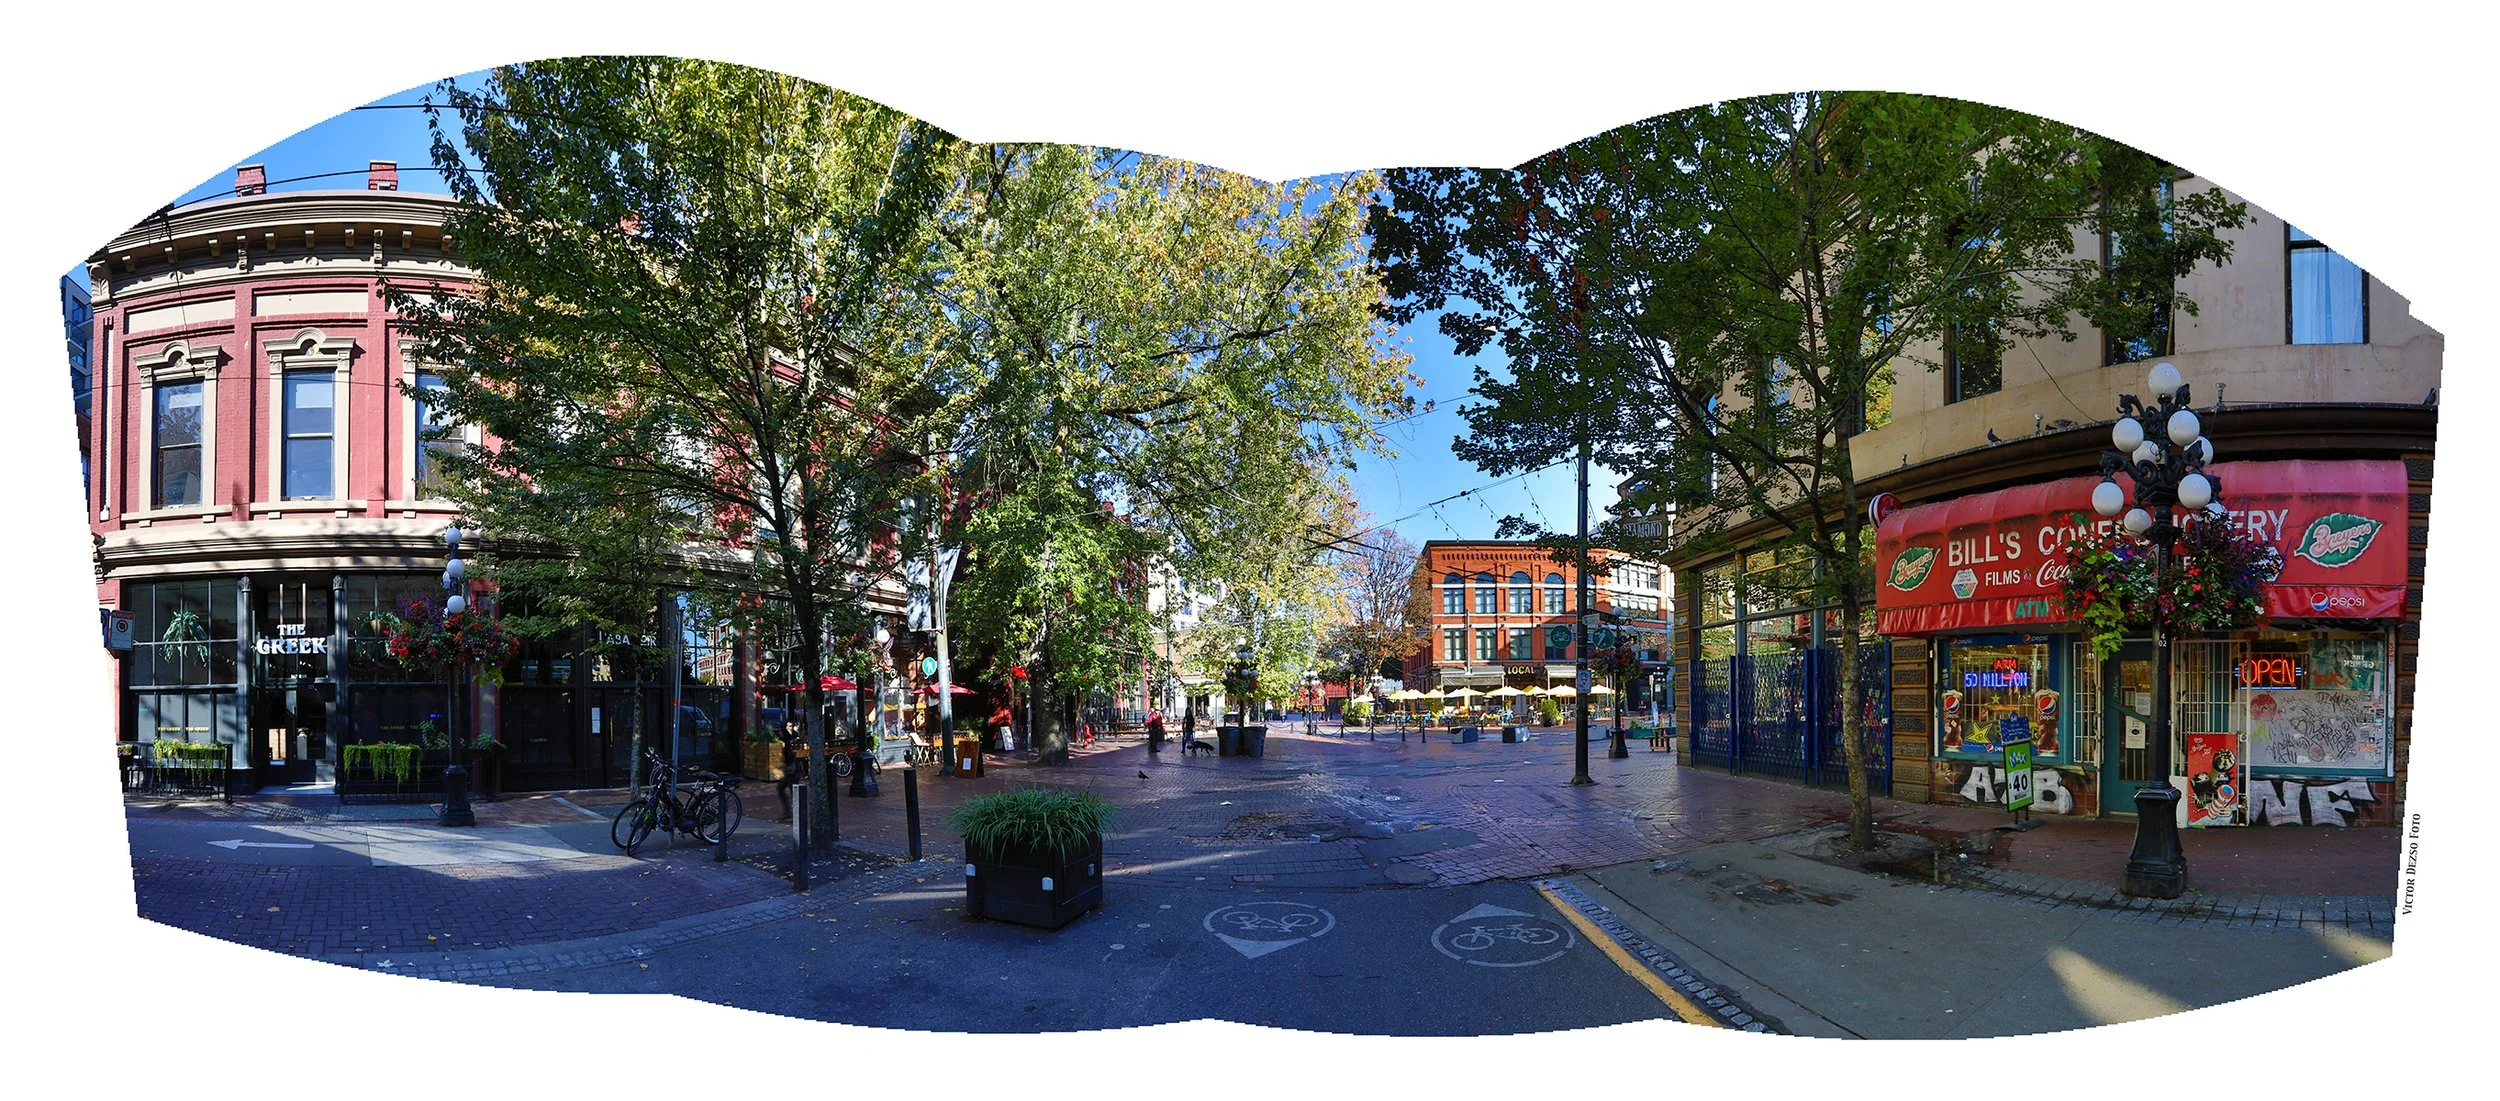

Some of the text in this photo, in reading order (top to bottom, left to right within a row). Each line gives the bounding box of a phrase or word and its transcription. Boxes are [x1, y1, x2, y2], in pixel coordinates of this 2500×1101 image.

[1948, 531, 2022, 567] BILL'S
[2309, 523, 2372, 558] Breyers
[1895, 550, 1933, 584] Breyers
[1985, 569, 2021, 586] FILMS
[2015, 600, 2049, 619] ATM
[2329, 597, 2365, 608] pepsi
[276, 624, 306, 636] THE
[256, 637, 326, 655] GREEK
[1507, 665, 1536, 675] LOCAL
[2240, 659, 2296, 685] OPEN
